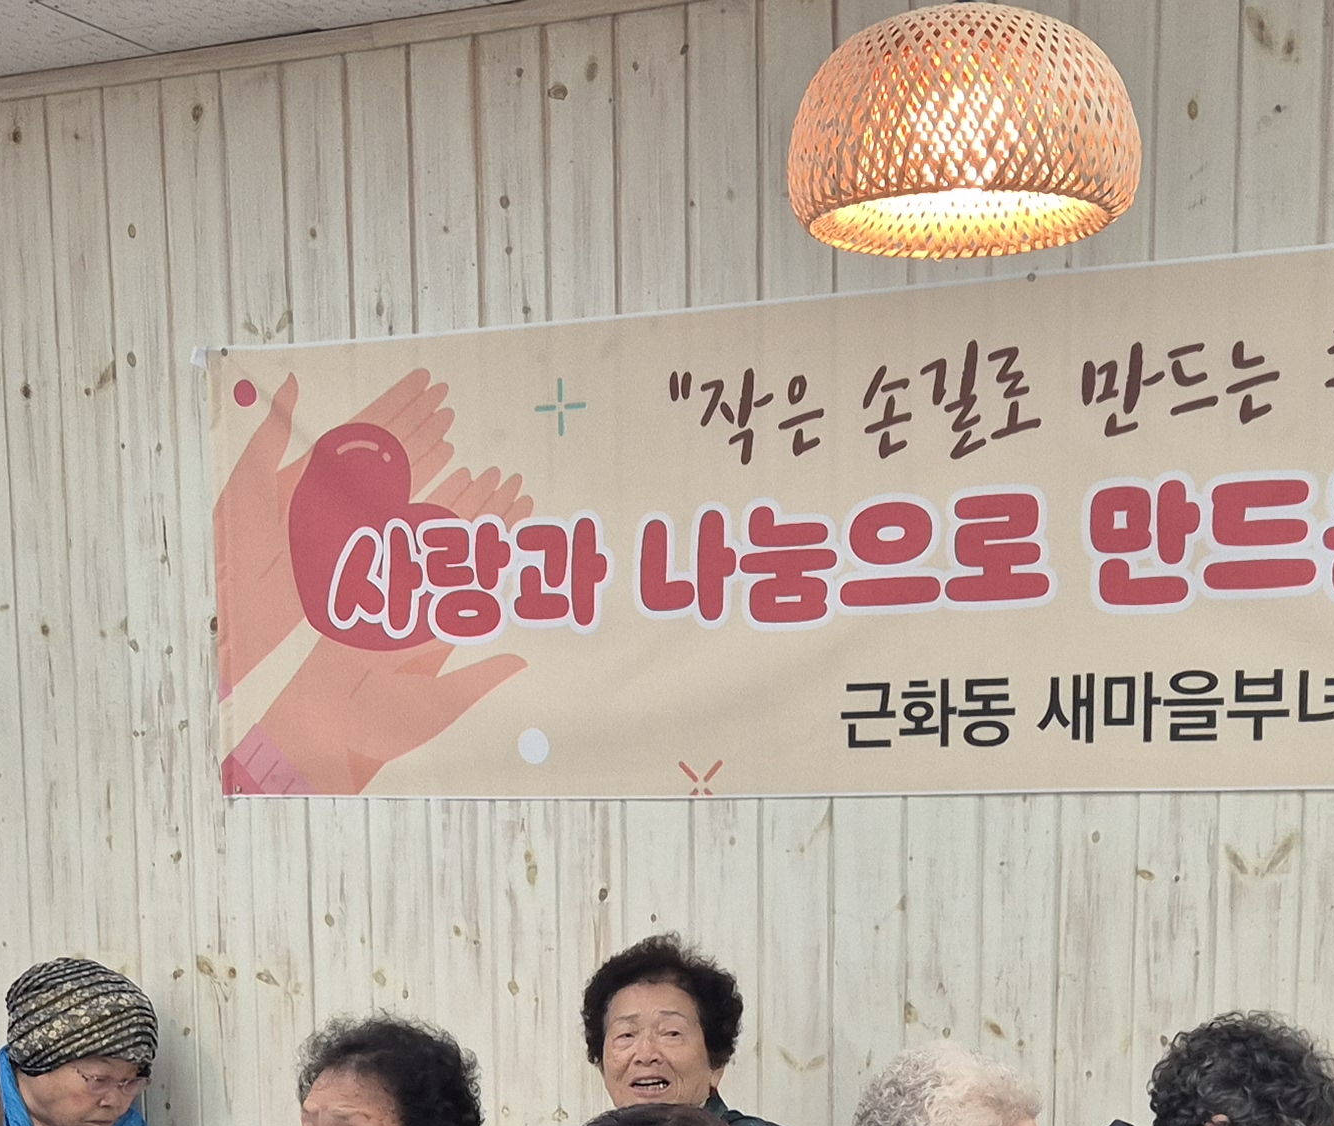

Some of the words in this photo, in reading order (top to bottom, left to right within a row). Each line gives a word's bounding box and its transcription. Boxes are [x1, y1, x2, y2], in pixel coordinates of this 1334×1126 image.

[668, 366, 827, 467] "작은
[861, 338, 1043, 461] 손길로
[1080, 339, 1281, 439] 만드는
[329, 512, 611, 640] 사랑과
[639, 490, 1053, 625] 나눔으로
[839, 676, 1017, 750] 근화동
